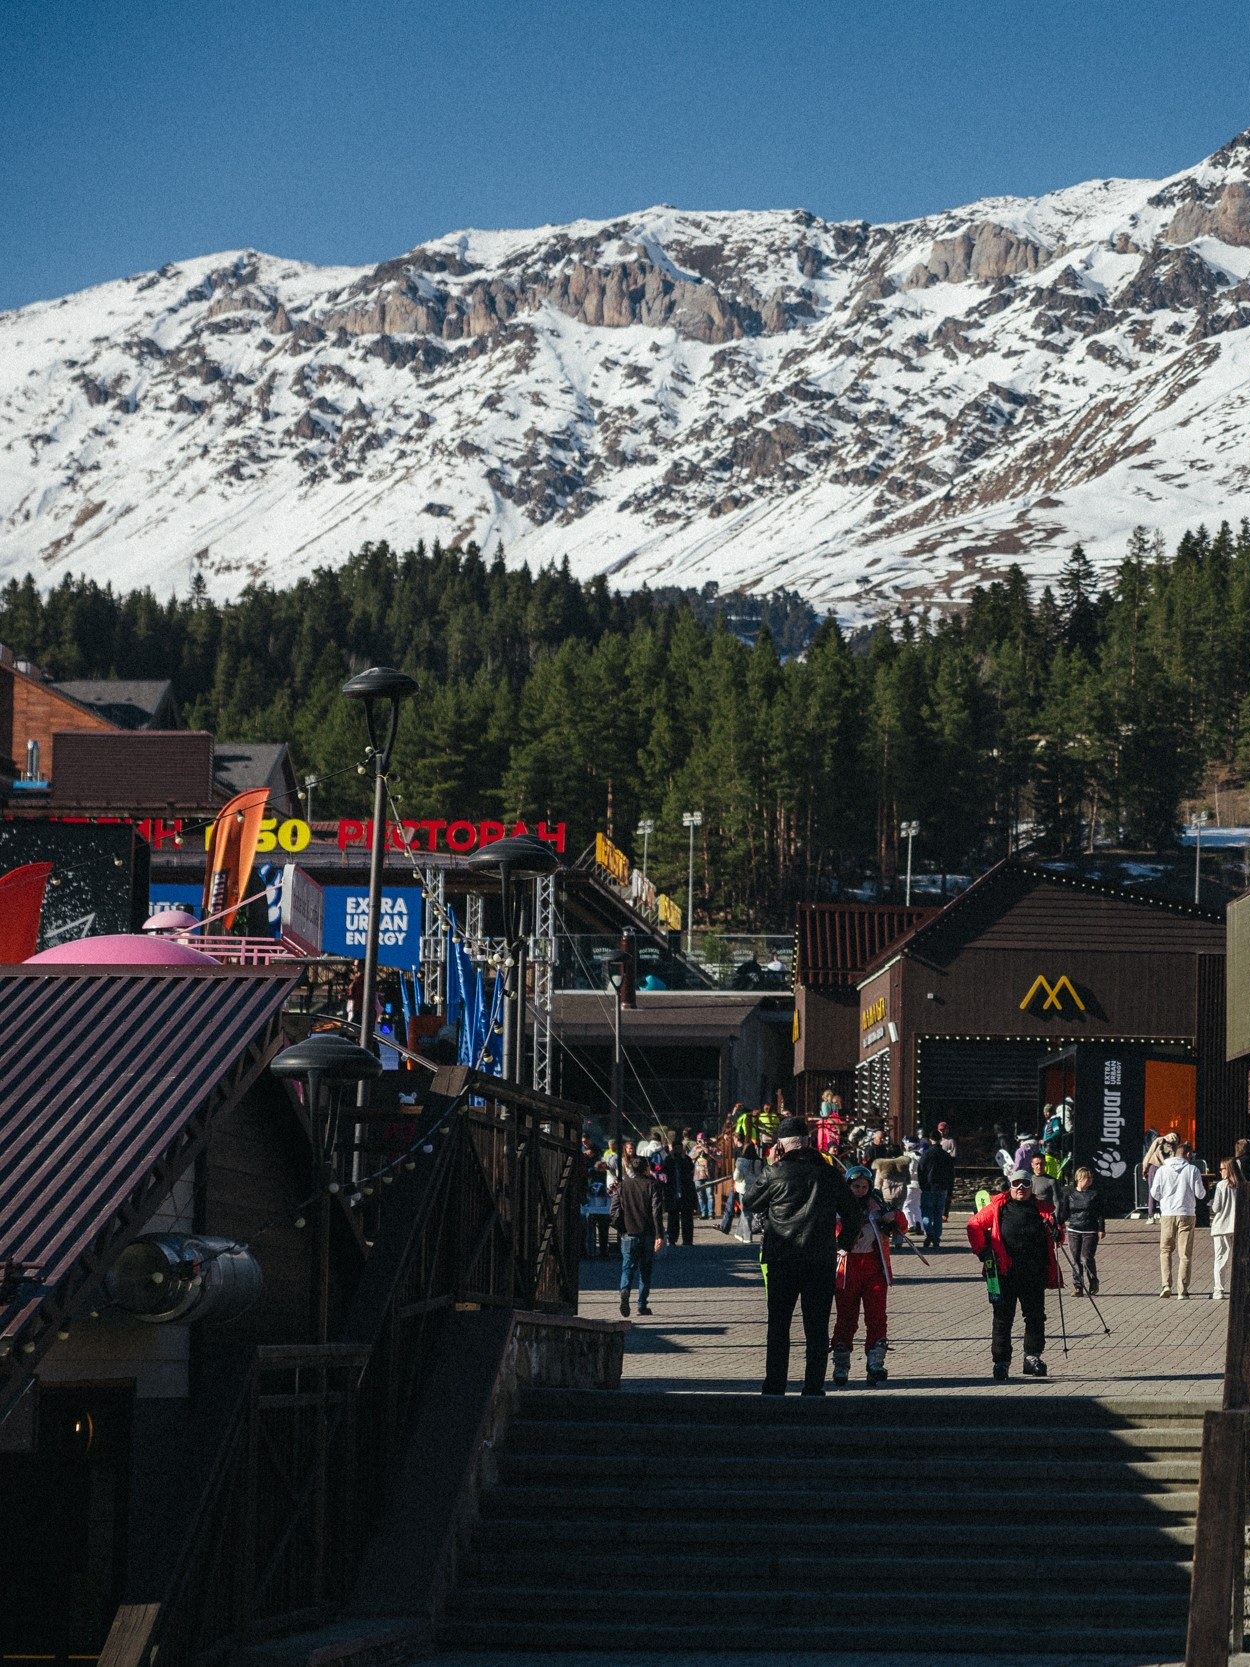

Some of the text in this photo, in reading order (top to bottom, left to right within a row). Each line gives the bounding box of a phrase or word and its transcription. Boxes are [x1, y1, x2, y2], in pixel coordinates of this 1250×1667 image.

[346, 897, 408, 914] EXRA
[346, 914, 408, 931] URAN
[345, 931, 407, 946] ENRGY
[1100, 1088, 1126, 1146] Jaguar
